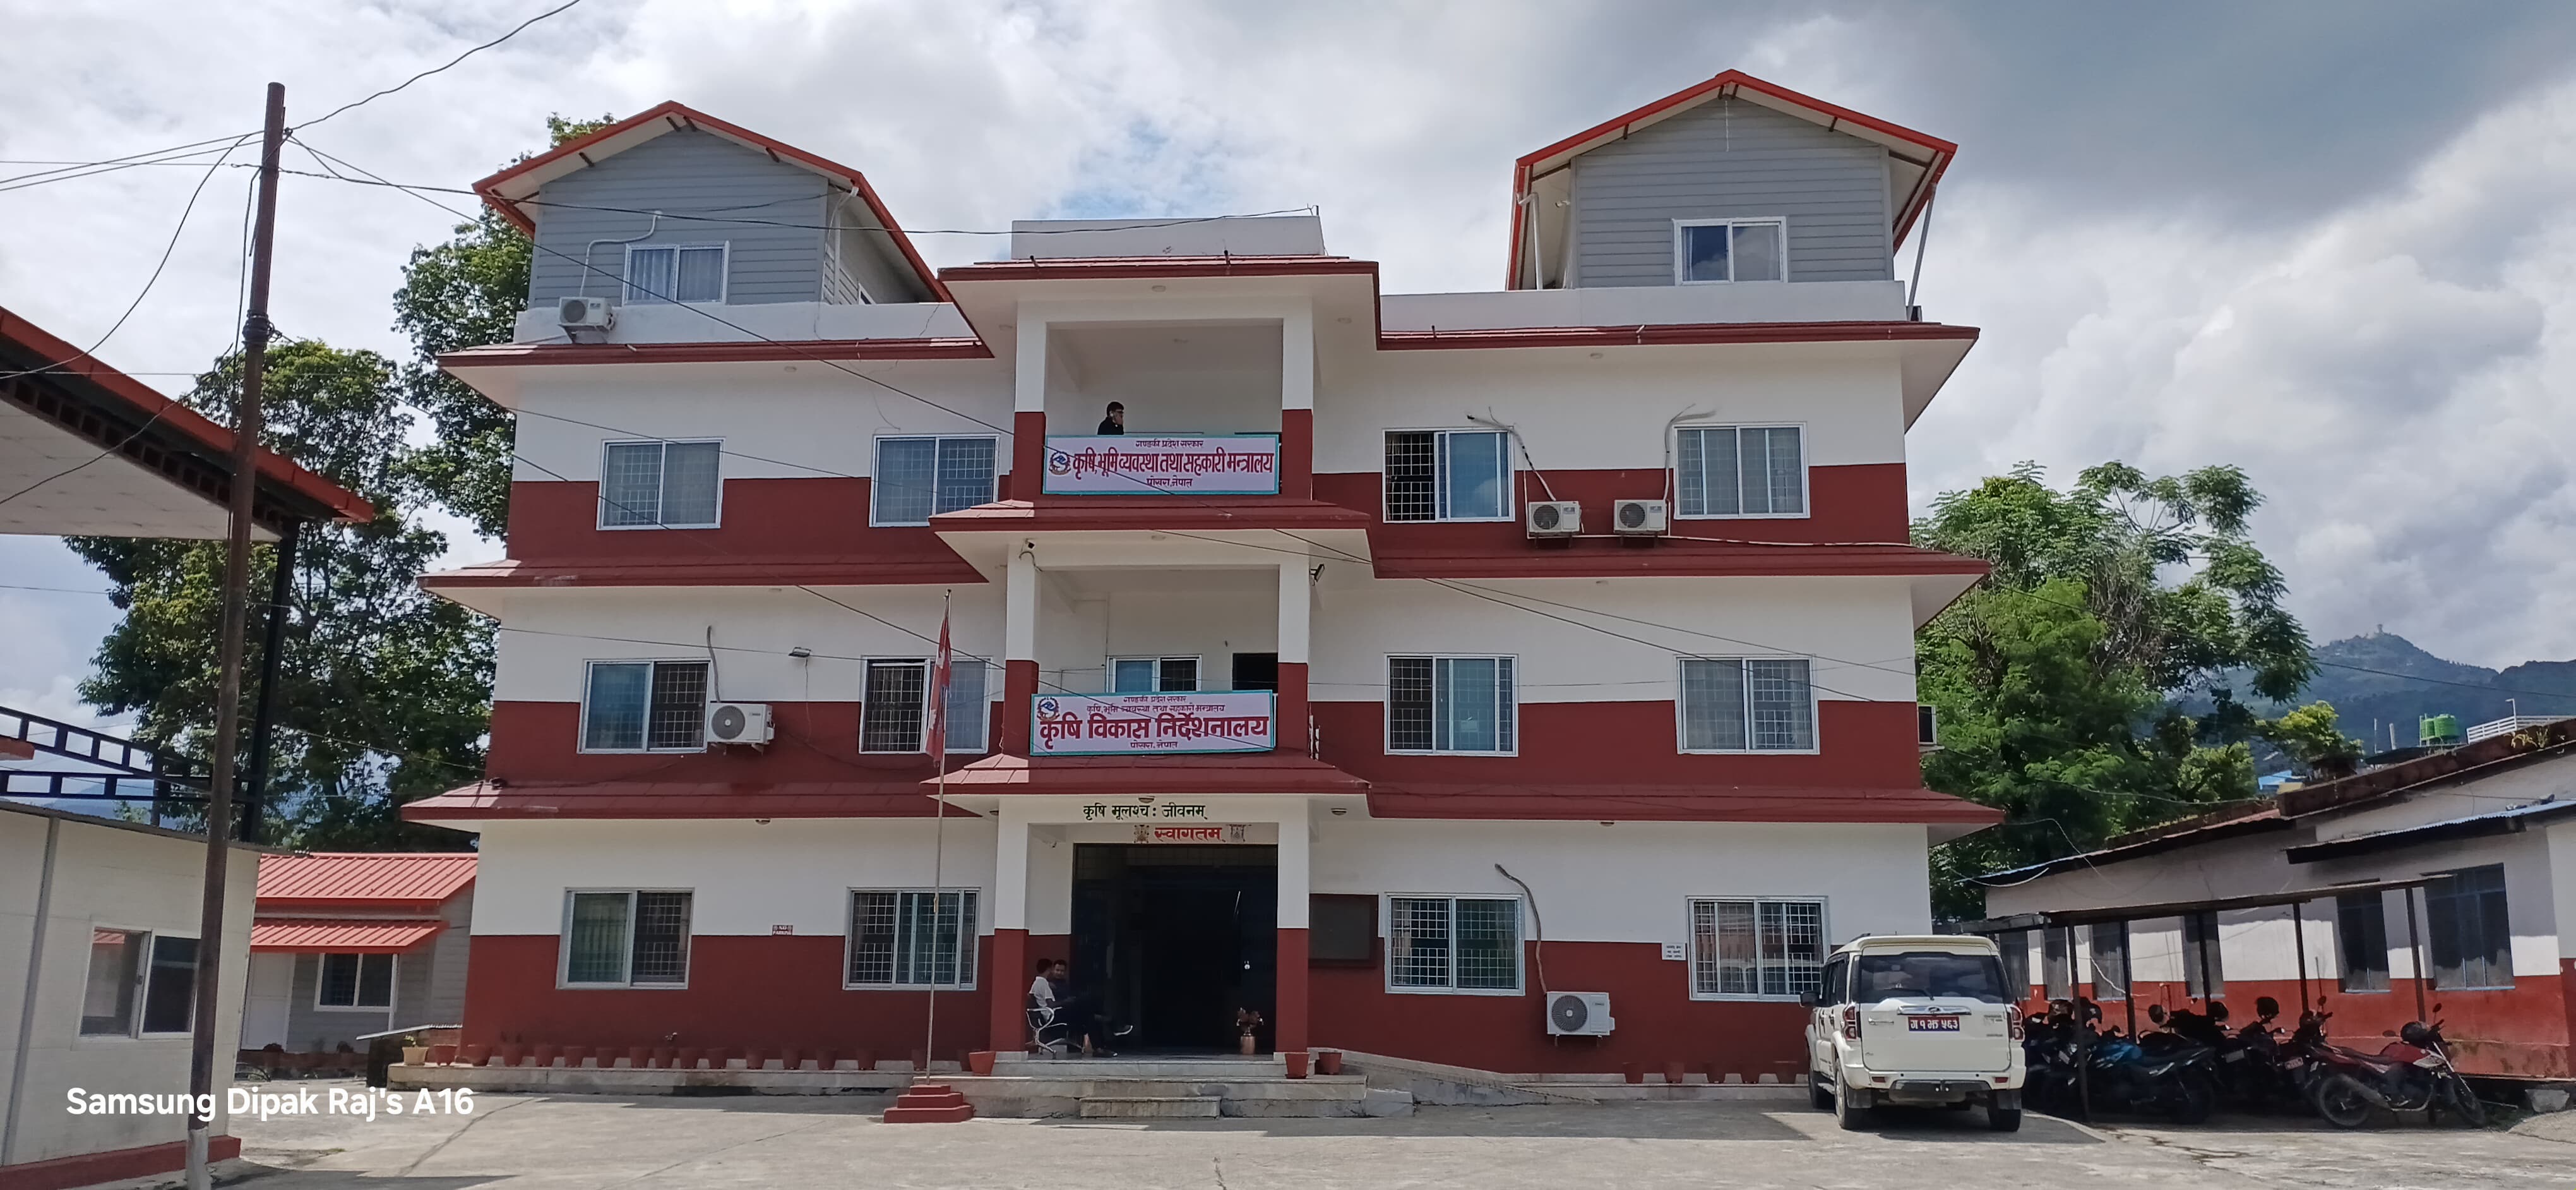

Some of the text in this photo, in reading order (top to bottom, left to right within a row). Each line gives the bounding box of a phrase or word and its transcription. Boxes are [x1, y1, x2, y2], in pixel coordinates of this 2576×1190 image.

[1179, 440, 1203, 449] सरकार
[1119, 453, 1159, 472] व्यवस्था
[1160, 453, 1183, 472] तथा
[1183, 447, 1226, 476] सहकारी
[1227, 452, 1274, 473] मन्त्रालय
[1040, 711, 1269, 750] कृषि विकास निर्देशनालय
[1083, 802, 1106, 820] कृषि
[1162, 802, 1208, 820] जीवनम्
[1154, 827, 1226, 843] स्वागतम्
